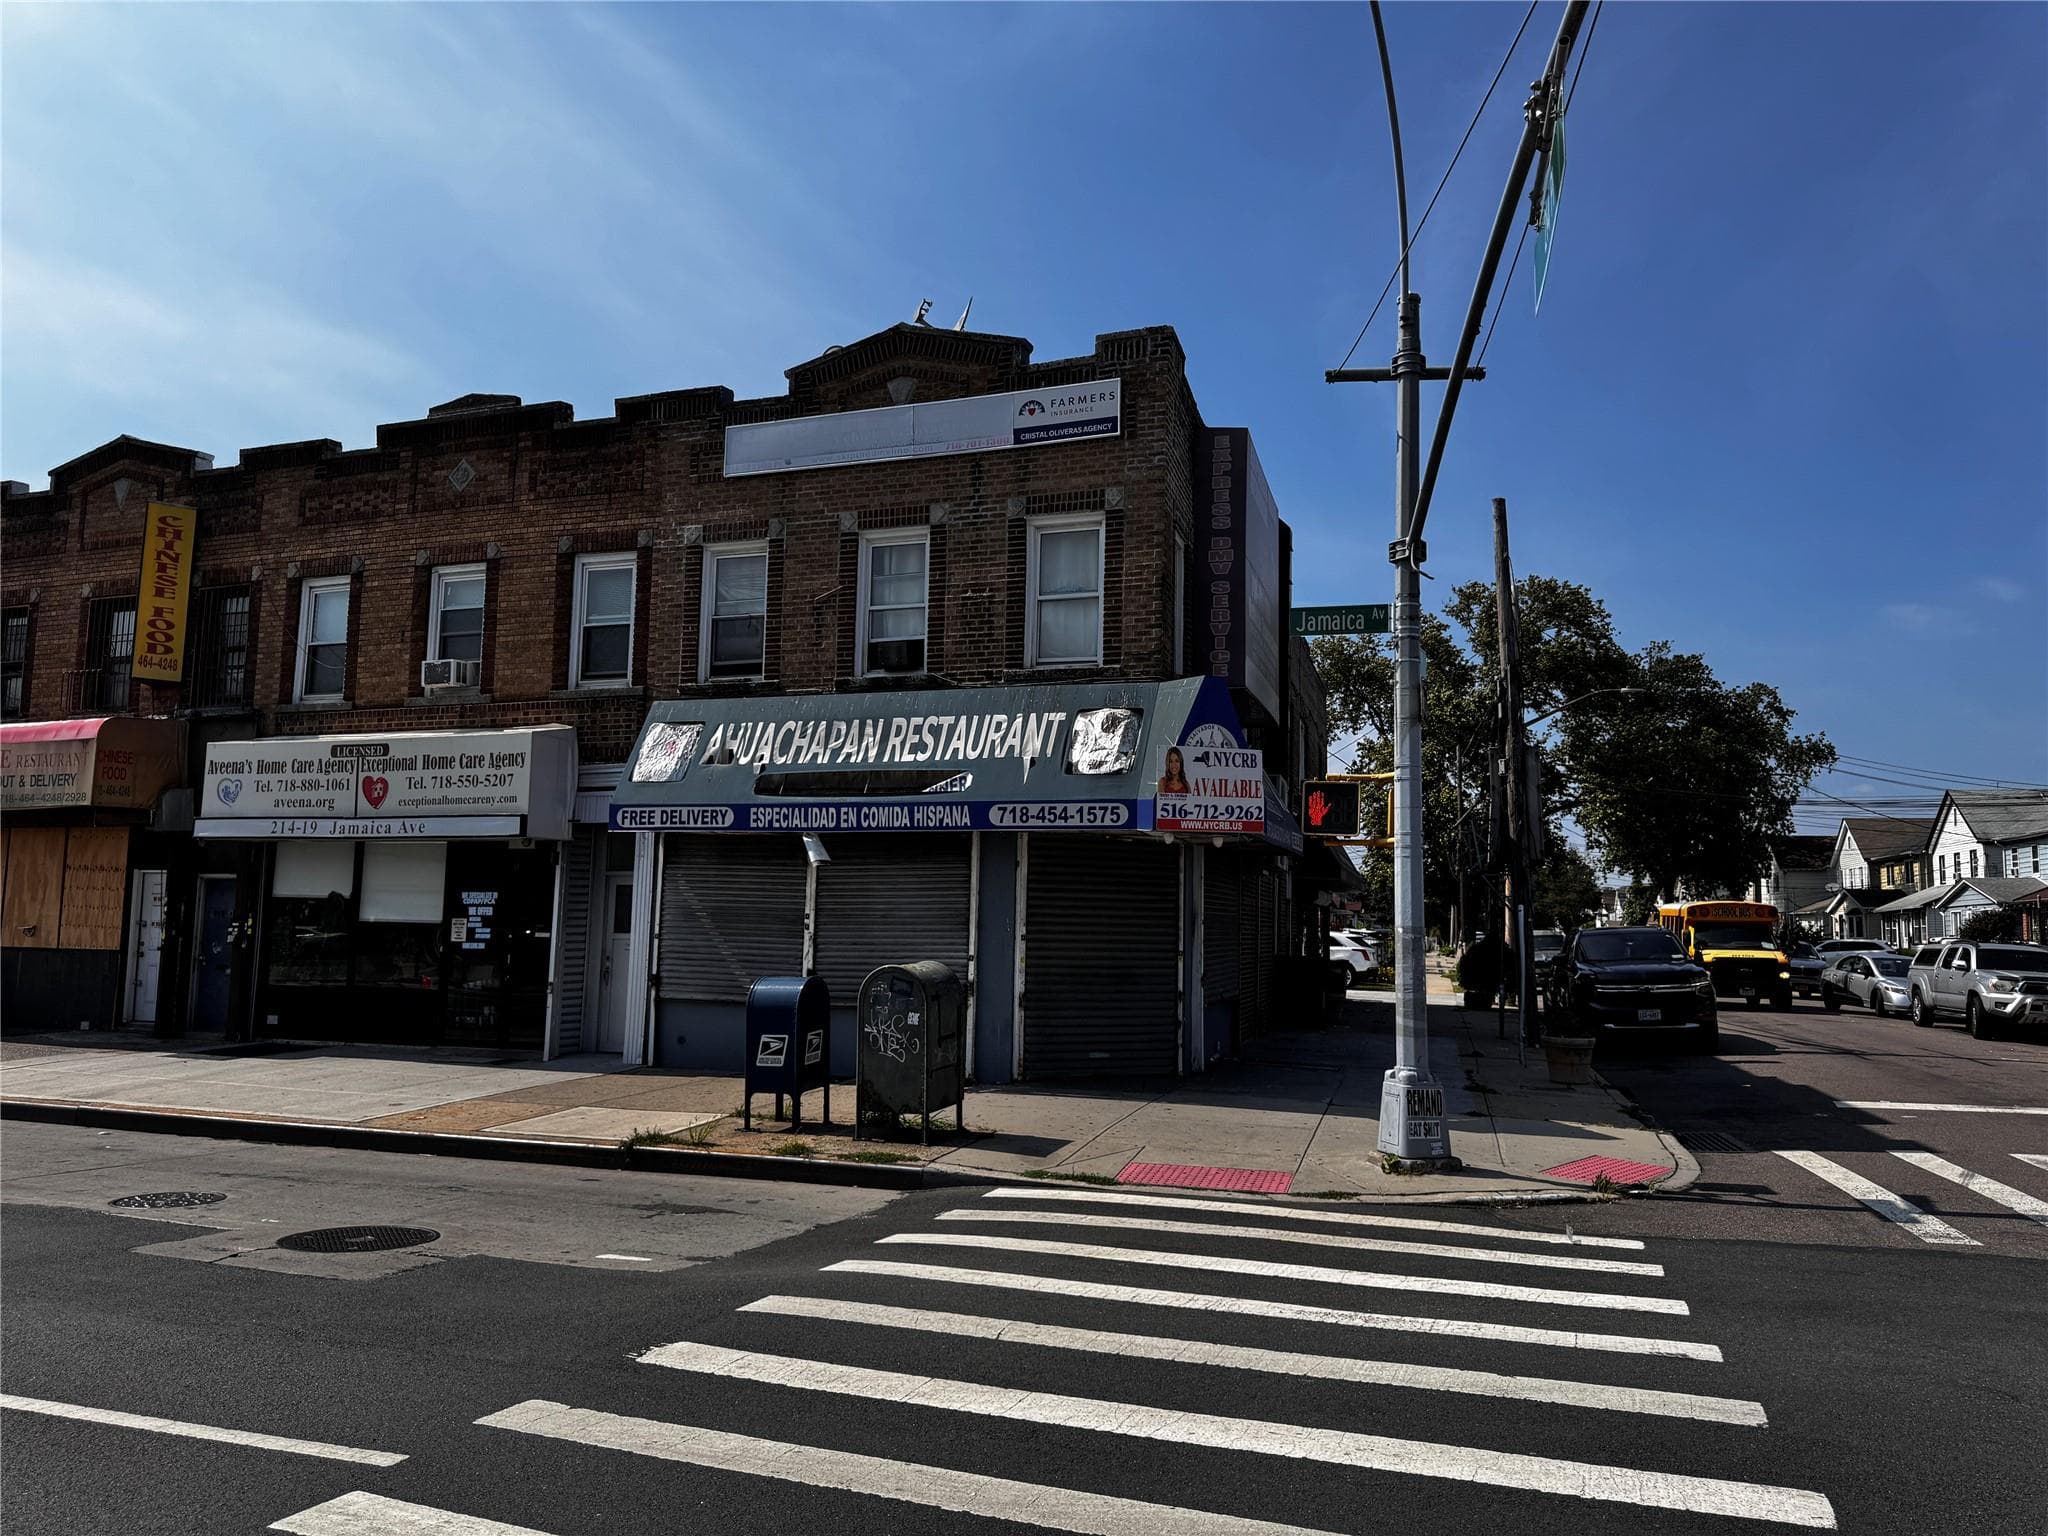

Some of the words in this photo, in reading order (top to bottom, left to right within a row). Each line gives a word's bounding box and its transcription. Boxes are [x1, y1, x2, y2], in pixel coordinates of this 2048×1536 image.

[1051, 391, 1116, 408] FARMERS
[1050, 406, 1094, 417] INSURANCE
[1020, 431, 1048, 440] CRISTAL
[1048, 427, 1082, 437] OLIVERAS
[1082, 423, 1113, 433] AGENCY
[1211, 435, 1232, 530] EXPRESS
[153, 515, 184, 600] CHINESE
[1208, 536, 1234, 575] DMV
[1209, 580, 1231, 677] SERVICE
[1296, 610, 1365, 632] Jamaica
[146, 606, 175, 655] FOOD
[137, 654, 178, 672] 464-4248
[699, 718, 884, 765] AHUACHAPAN
[883, 711, 1067, 763] RESTAURANT
[98, 750, 134, 765] CHINESE
[336, 744, 384, 757] LICENSED
[16, 752, 89, 768] RESTAURANT
[208, 759, 252, 775] Aveena's
[256, 759, 287, 775] Home
[291, 758, 315, 774] Care
[316, 757, 356, 776] Agency
[360, 754, 417, 774] Exceptional
[422, 754, 456, 770] Home
[459, 753, 485, 769] Care
[488, 751, 526, 770] Agency
[1213, 751, 1258, 769] NYCRB
[18, 775, 26, 788] &
[30, 773, 77, 787] DELIVERY
[102, 766, 127, 780] FOOD
[254, 780, 273, 793] Tel.
[277, 778, 350, 793] 718-880-1061
[405, 776, 427, 790] Tel.
[431, 774, 514, 789] 718-550-5207
[1192, 778, 1262, 798] AVAILABLE
[274, 797, 335, 811] aveena.org
[398, 794, 518, 808] exceptionalhomecareny.com
[621, 809, 655, 826] FREE
[660, 808, 729, 825] DELIVERY
[750, 807, 837, 828] ESPECIALIDAD
[840, 807, 857, 828] EN
[860, 806, 911, 828] COMIDA
[914, 805, 971, 828] HISPANA
[997, 806, 1121, 824] 718-454-1575
[1160, 803, 1263, 820] 516-712-9262
[270, 820, 318, 835] 214-19
[329, 821, 393, 836] Jamaica
[397, 820, 426, 834] Ave
[1180, 820, 1243, 831] WWW.NYCRB.US
